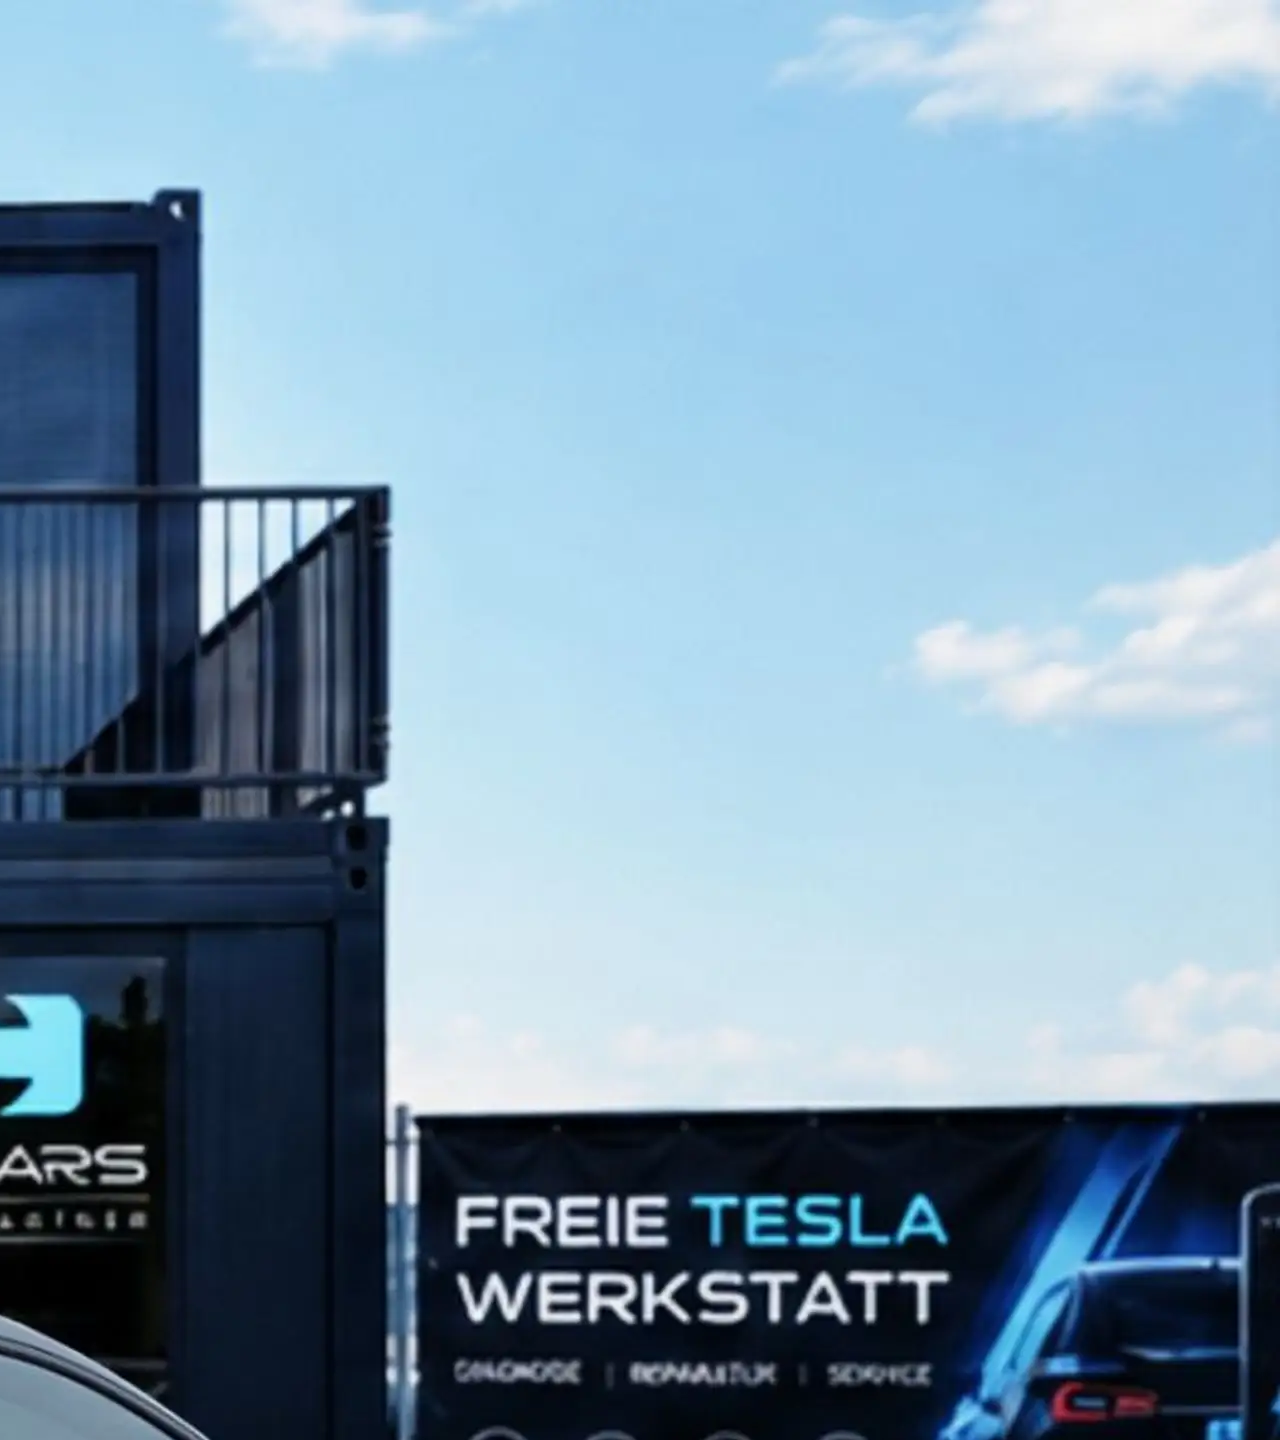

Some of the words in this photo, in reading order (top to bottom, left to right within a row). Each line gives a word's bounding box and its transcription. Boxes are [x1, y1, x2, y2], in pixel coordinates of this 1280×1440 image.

[456, 1195, 669, 1248] FREIE
[690, 1193, 948, 1248] TESLA
[457, 1270, 950, 1325] WERKSTATT
